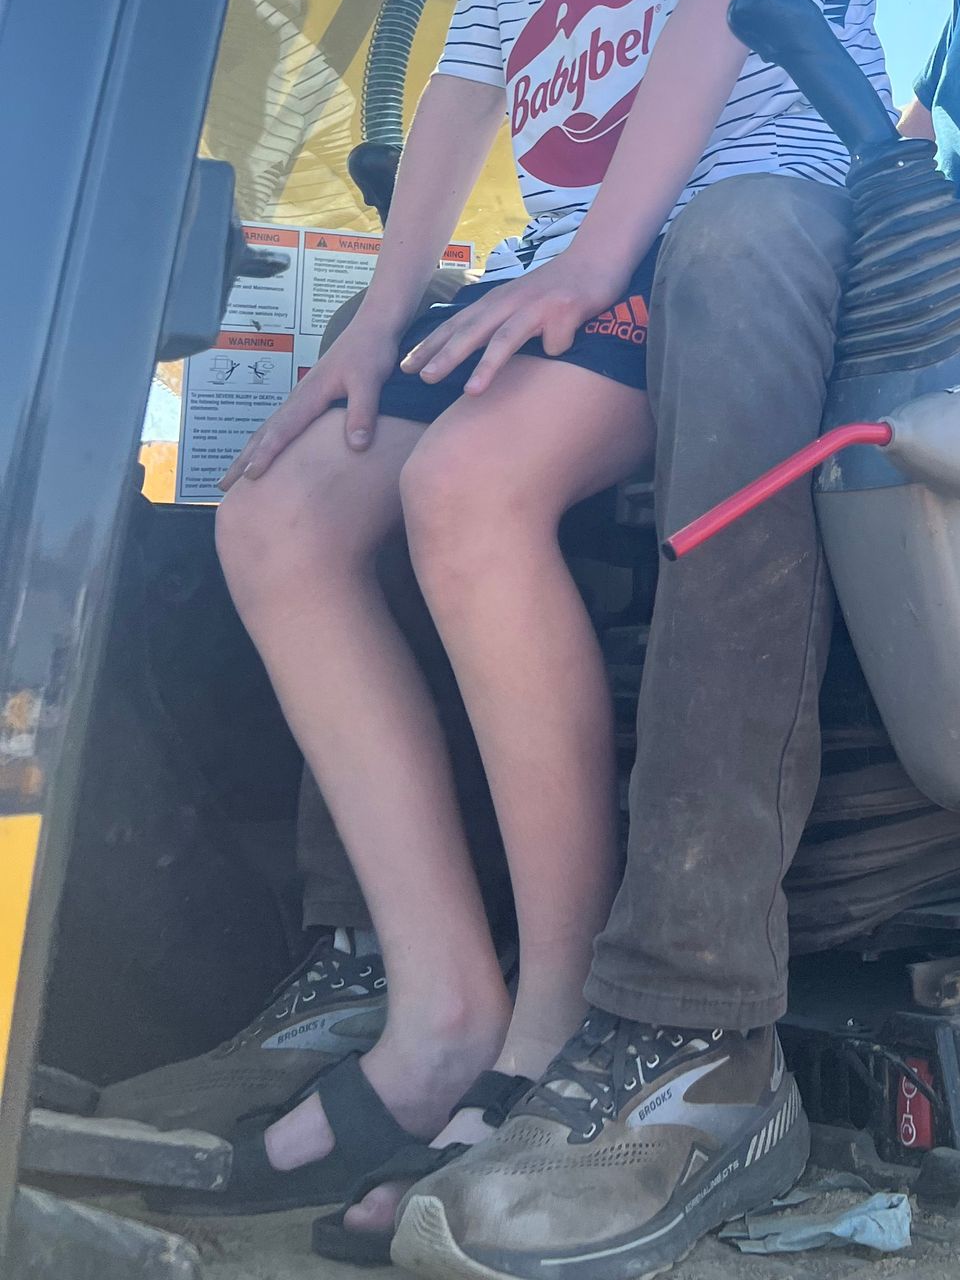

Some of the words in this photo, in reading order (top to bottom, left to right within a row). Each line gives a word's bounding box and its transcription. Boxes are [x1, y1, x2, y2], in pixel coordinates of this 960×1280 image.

[245, 232, 280, 243] ARNING
[339, 239, 381, 252] WARNING
[443, 250, 464, 259] NING
[585, 319, 645, 344] adida
[228, 337, 274, 347] WARNING
[638, 1087, 673, 1121] BROOKS
